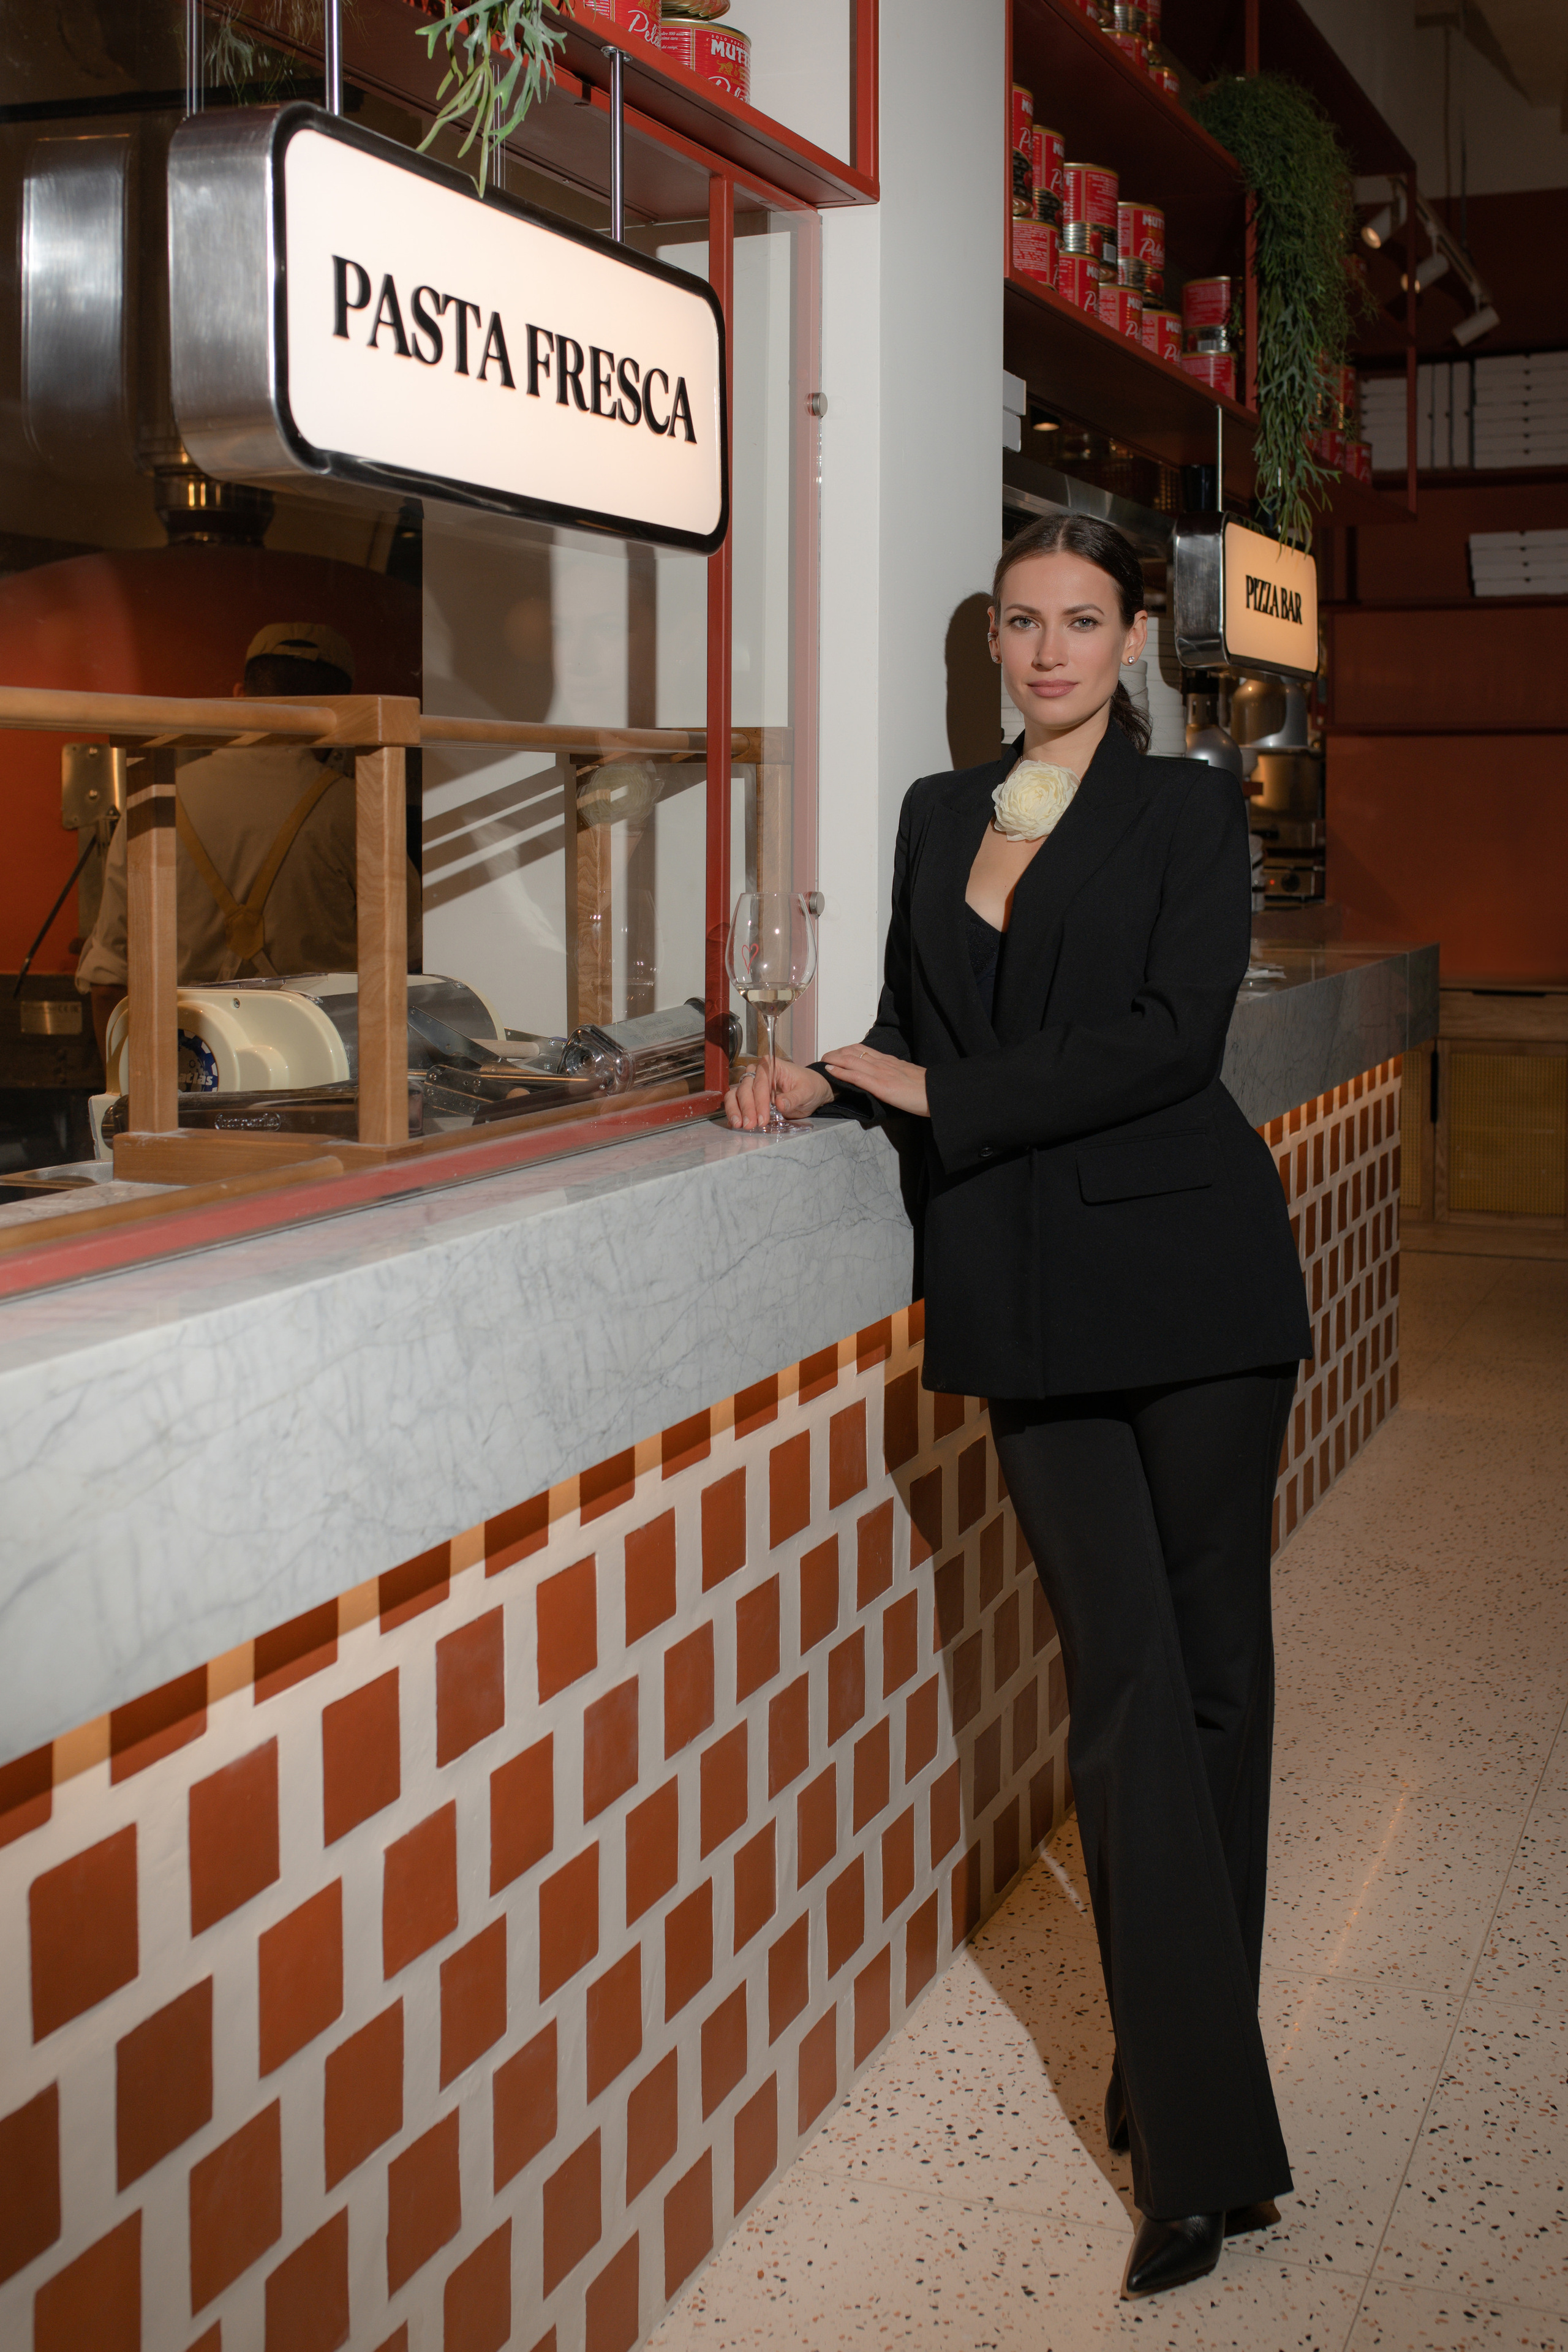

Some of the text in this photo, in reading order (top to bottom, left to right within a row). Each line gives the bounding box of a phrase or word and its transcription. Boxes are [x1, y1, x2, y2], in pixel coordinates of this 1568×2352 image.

[333, 254, 698, 445] PASTA FRESCA
[1245, 575, 1303, 625] PIZZA BAR
